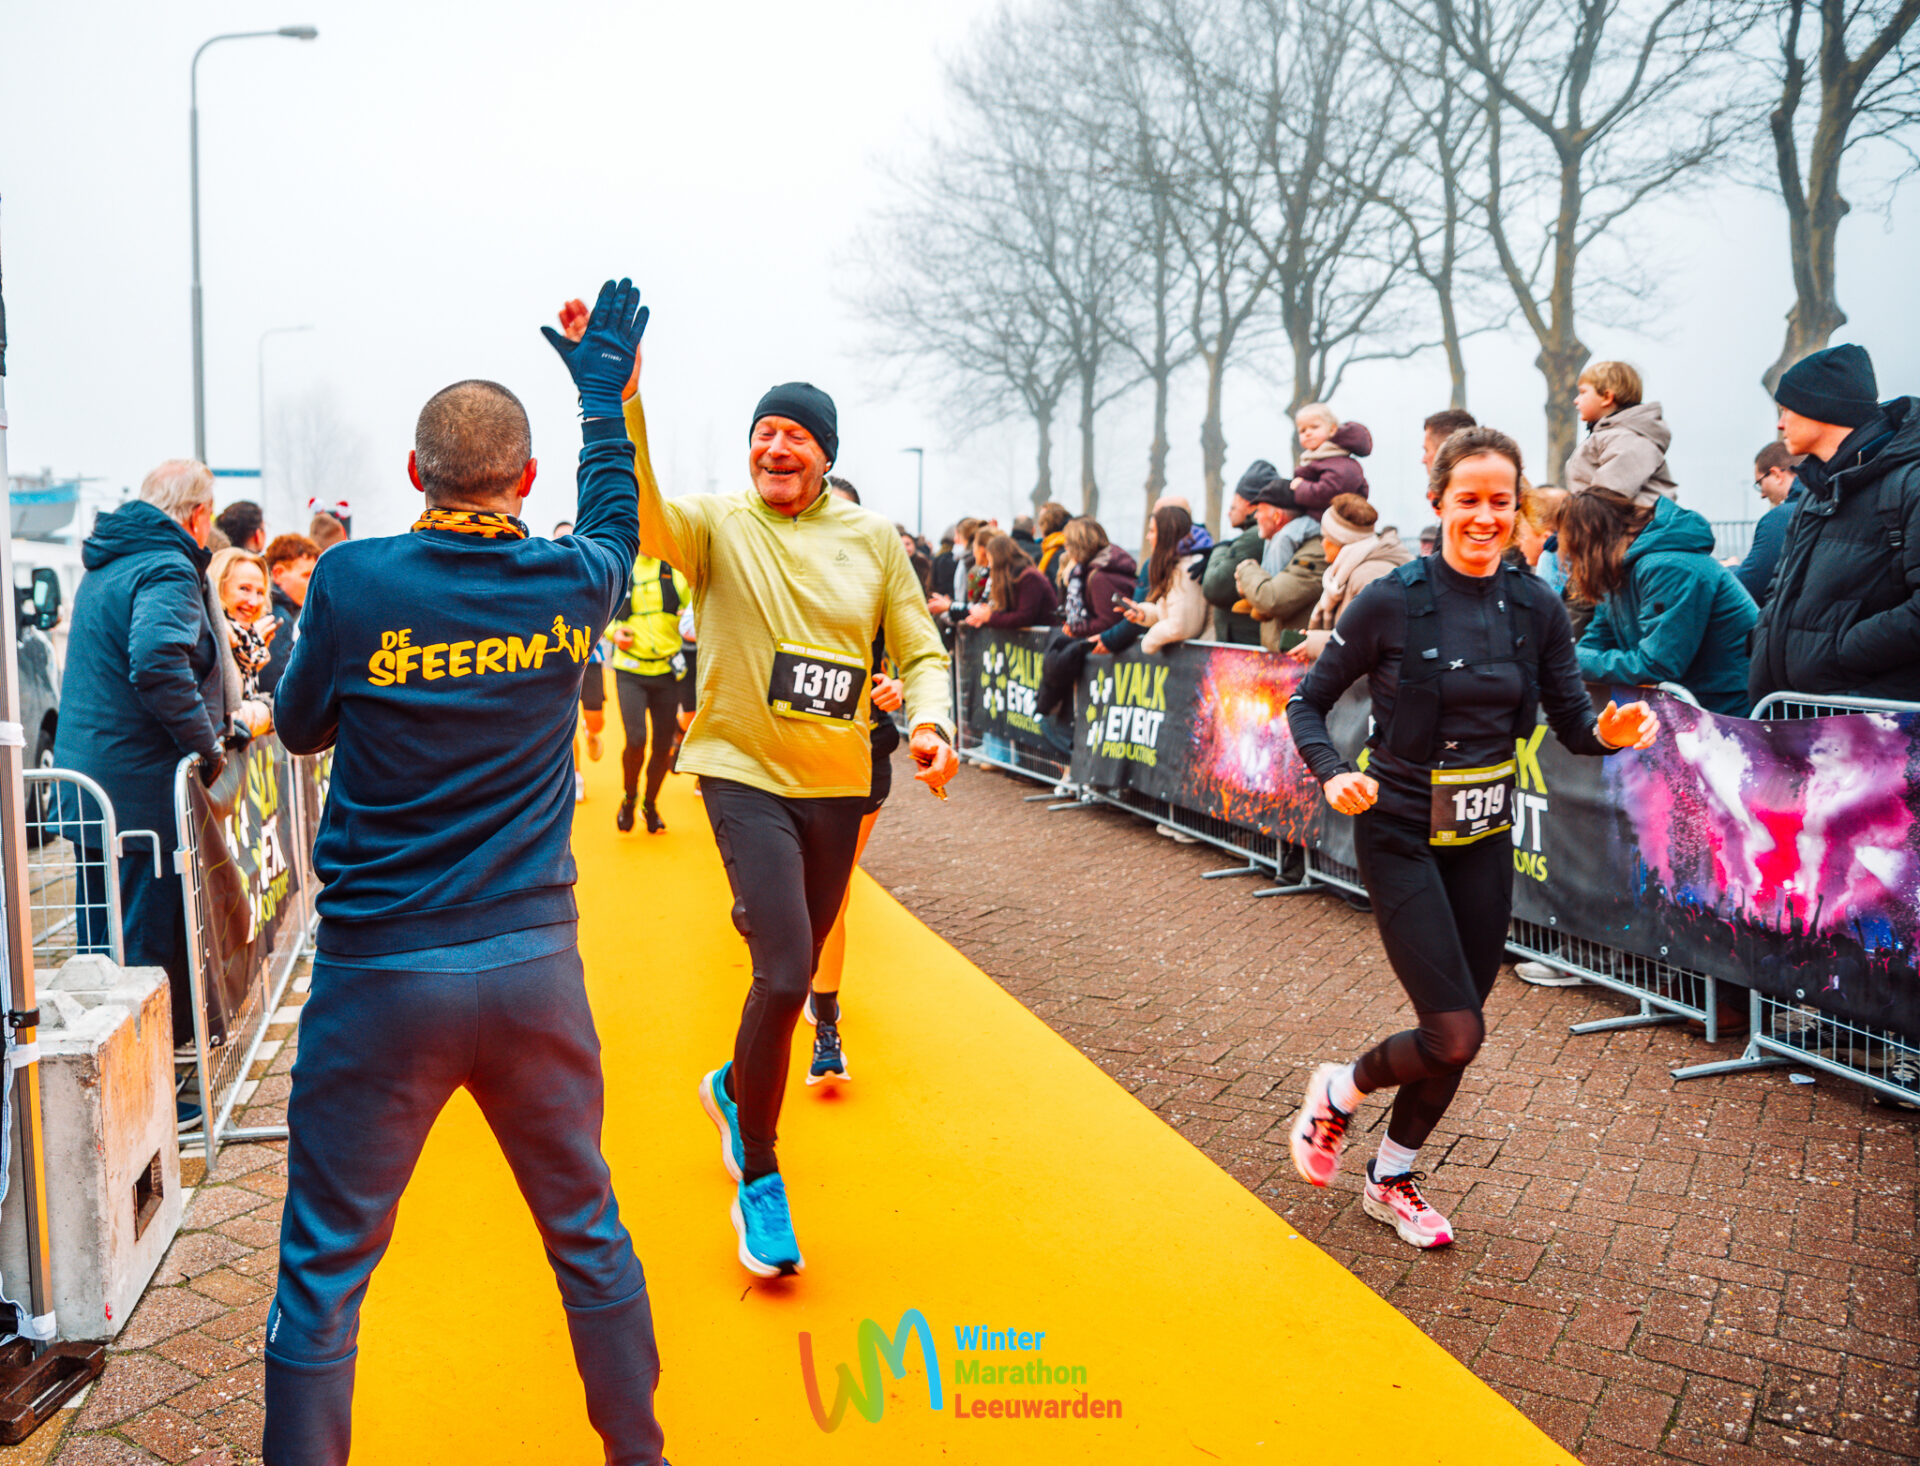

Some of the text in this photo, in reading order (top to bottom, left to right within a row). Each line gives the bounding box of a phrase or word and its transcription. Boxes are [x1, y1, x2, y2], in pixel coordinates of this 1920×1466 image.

[381, 628, 412, 650] DE
[792, 662, 852, 703] 1318
[1114, 662, 1170, 712] VALK
[1452, 783, 1506, 821] 1319
